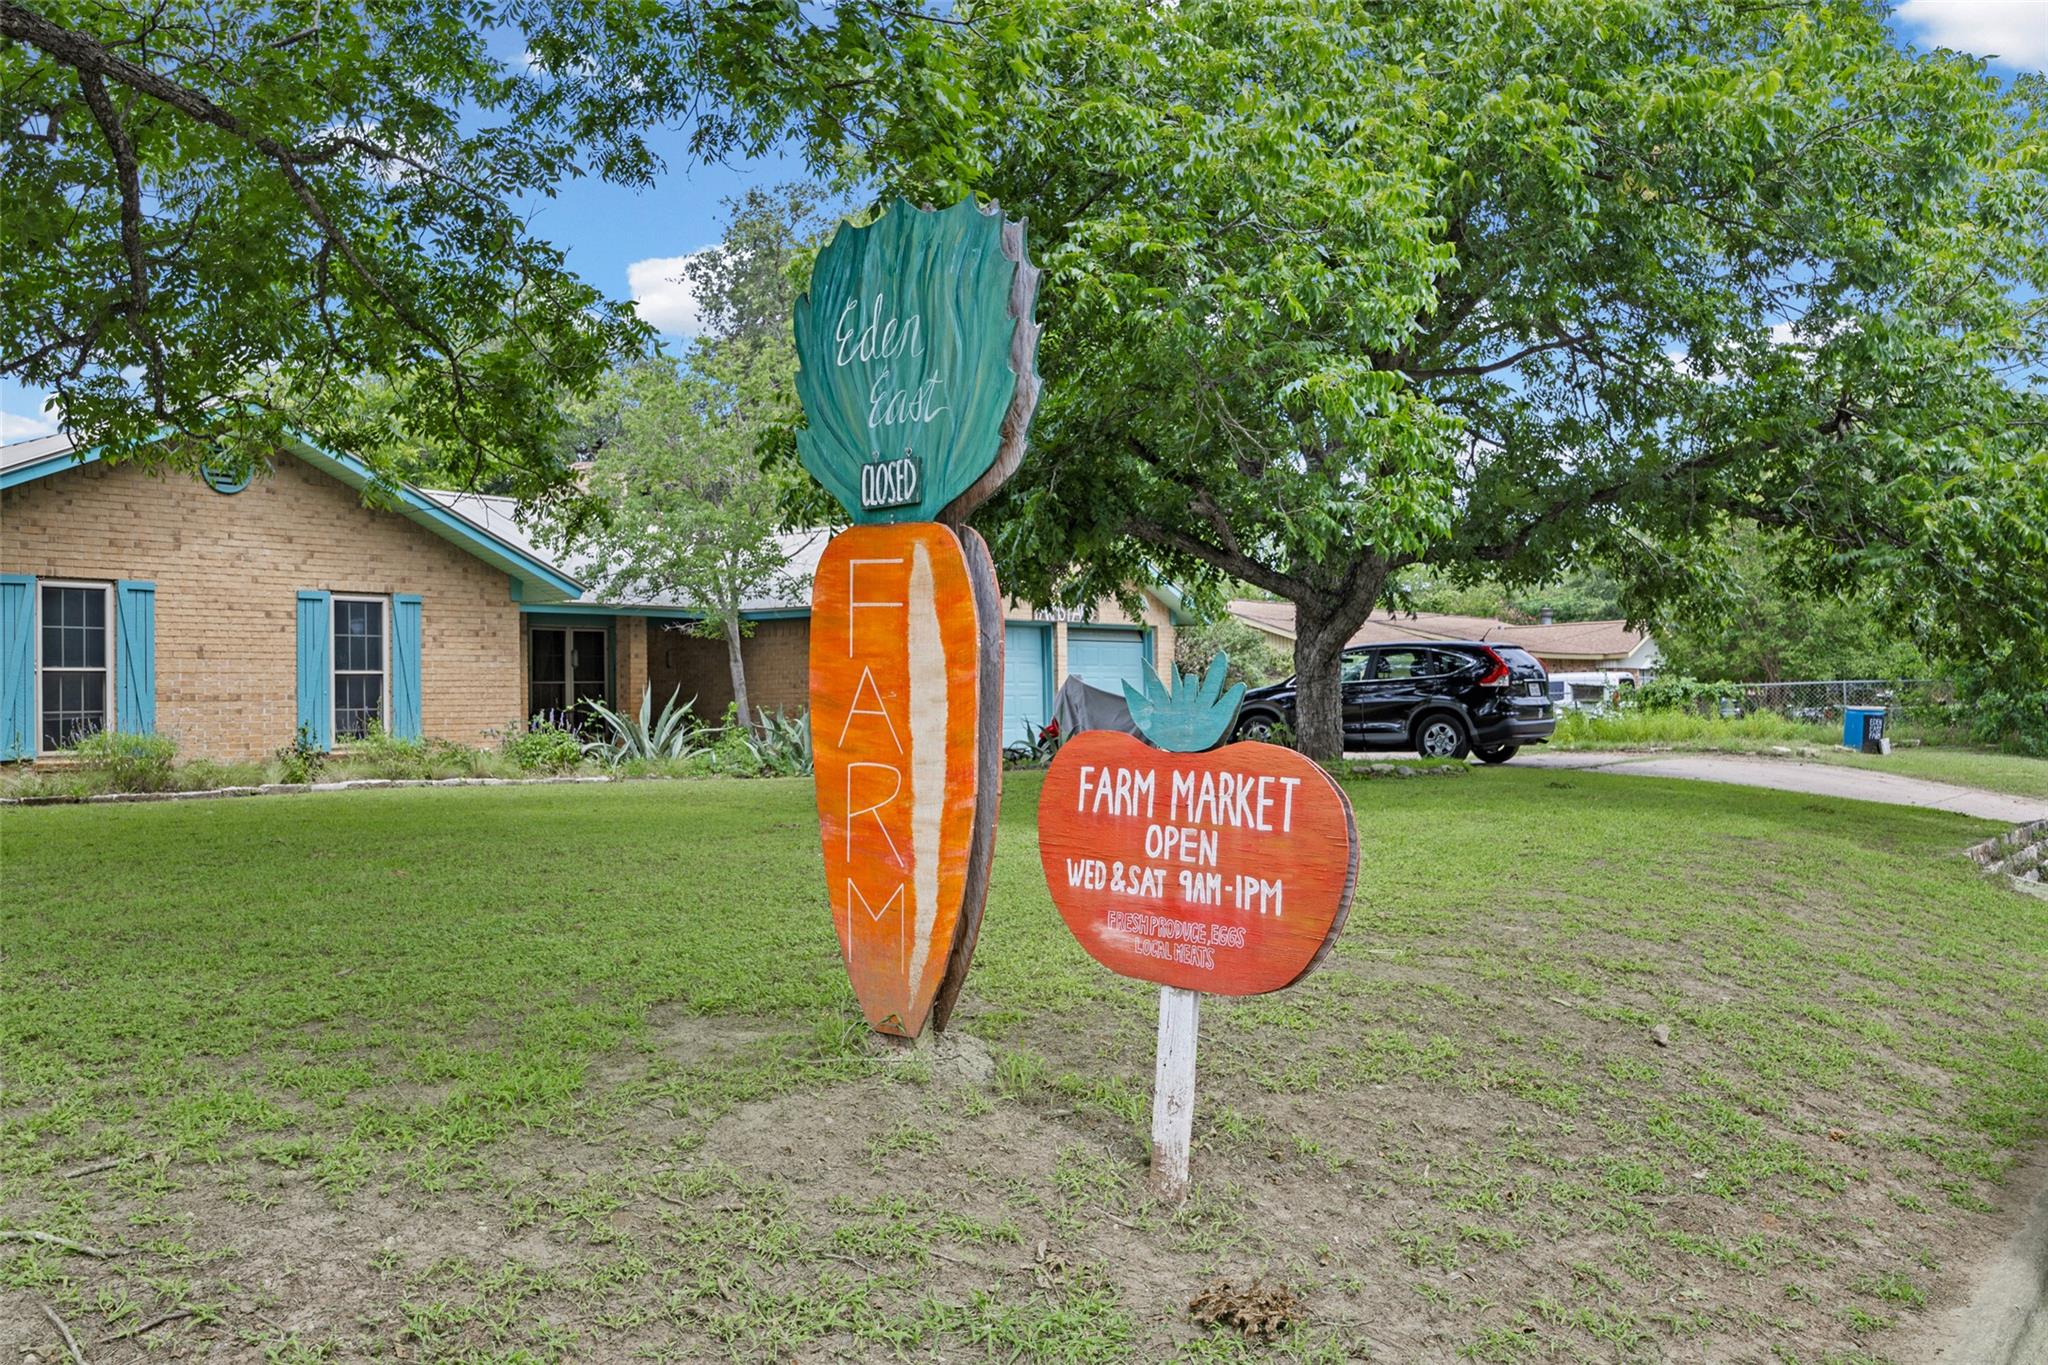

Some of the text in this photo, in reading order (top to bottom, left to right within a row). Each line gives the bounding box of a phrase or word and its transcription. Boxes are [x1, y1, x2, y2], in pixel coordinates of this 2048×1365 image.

[836, 293, 924, 367] Eden
[869, 367, 950, 428] East
[862, 459, 916, 506] CLOSED
[838, 557, 905, 976] FARM
[1078, 766, 1301, 832] FARM MARKET
[1145, 824, 1218, 867] OPEN
[1107, 910, 1149, 934] FRESH
[1134, 937, 1216, 971] LOCAL MEATS
